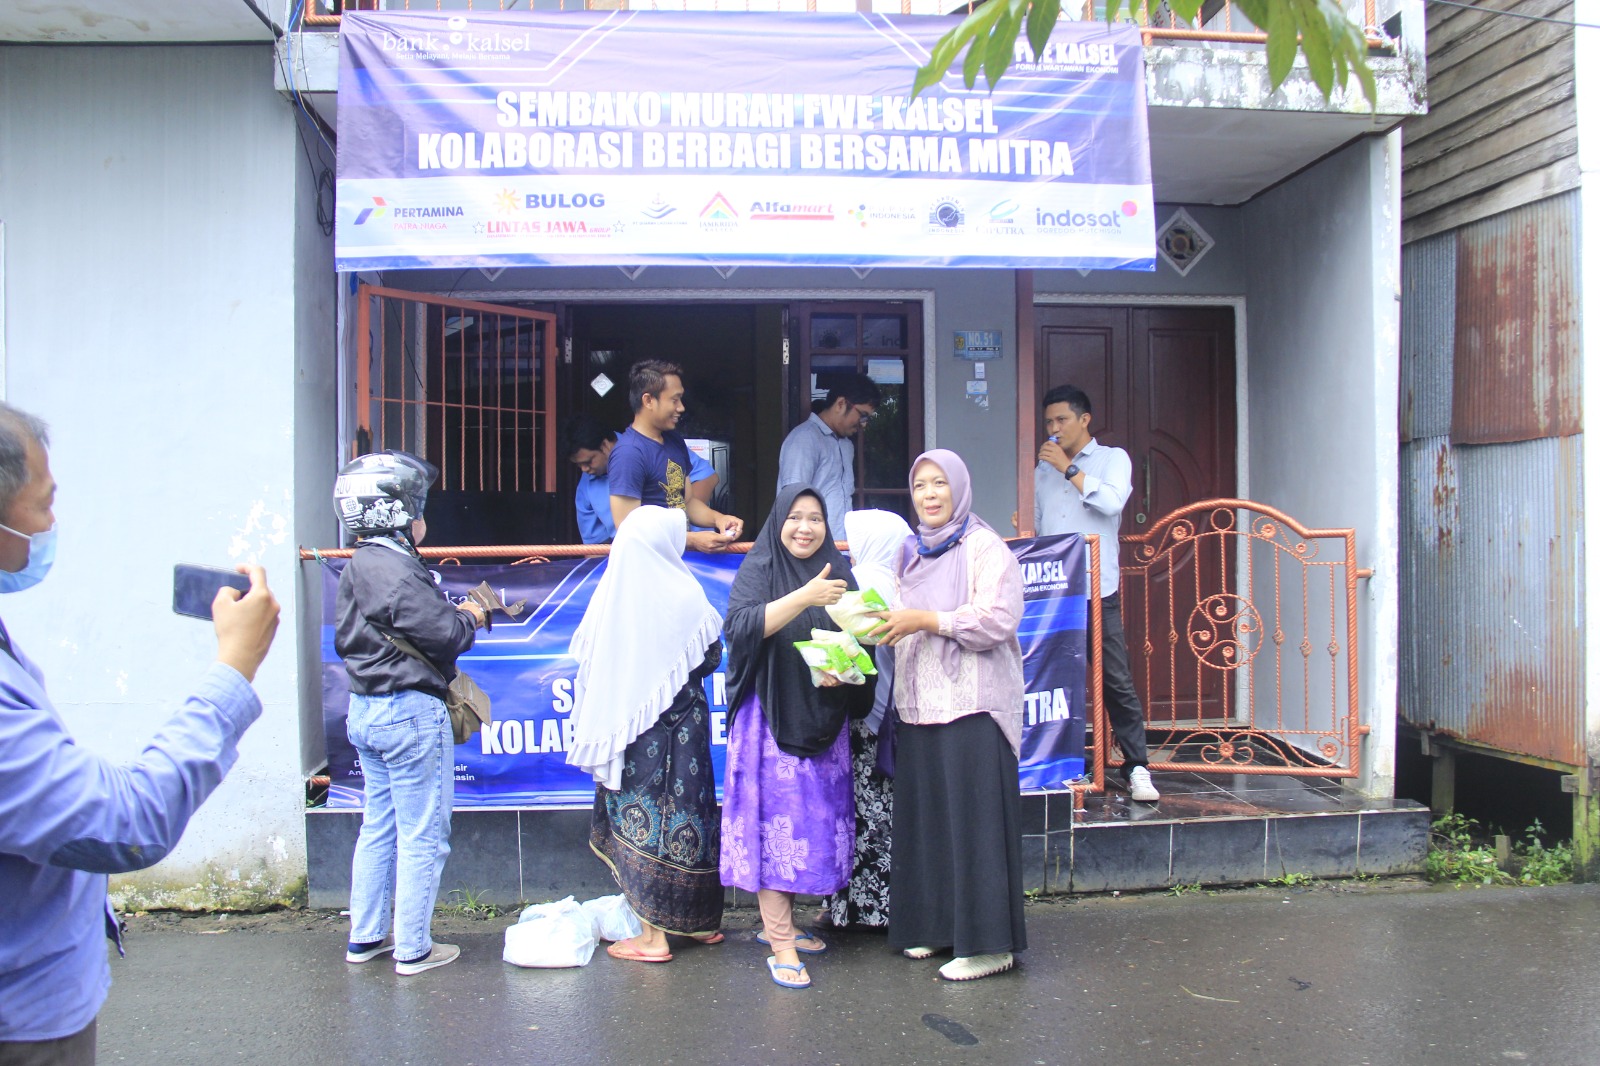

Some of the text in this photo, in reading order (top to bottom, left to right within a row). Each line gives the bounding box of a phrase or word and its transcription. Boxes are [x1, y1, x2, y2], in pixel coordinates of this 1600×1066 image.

[382, 31, 531, 51] bank kalsel
[1056, 43, 1118, 65] KALSEL
[1043, 65, 1084, 73] WARTAWAN
[496, 91, 998, 134] SEMBAKO MURAH FWE KALSEL
[418, 131, 1074, 176] KOLABORASI BERBAGI BERSAMA MITRA
[525, 193, 605, 208] BULOG
[750, 201, 834, 213] Alfamart
[394, 206, 464, 217] PERTAMINA
[1036, 207, 1121, 227] indosat
[420, 222, 448, 230] NIAGA
[487, 220, 541, 233] LINTAS
[544, 220, 588, 233] JAWA
[1040, 583, 1068, 591] EKONOMI
[1024, 688, 1070, 725] TRA
